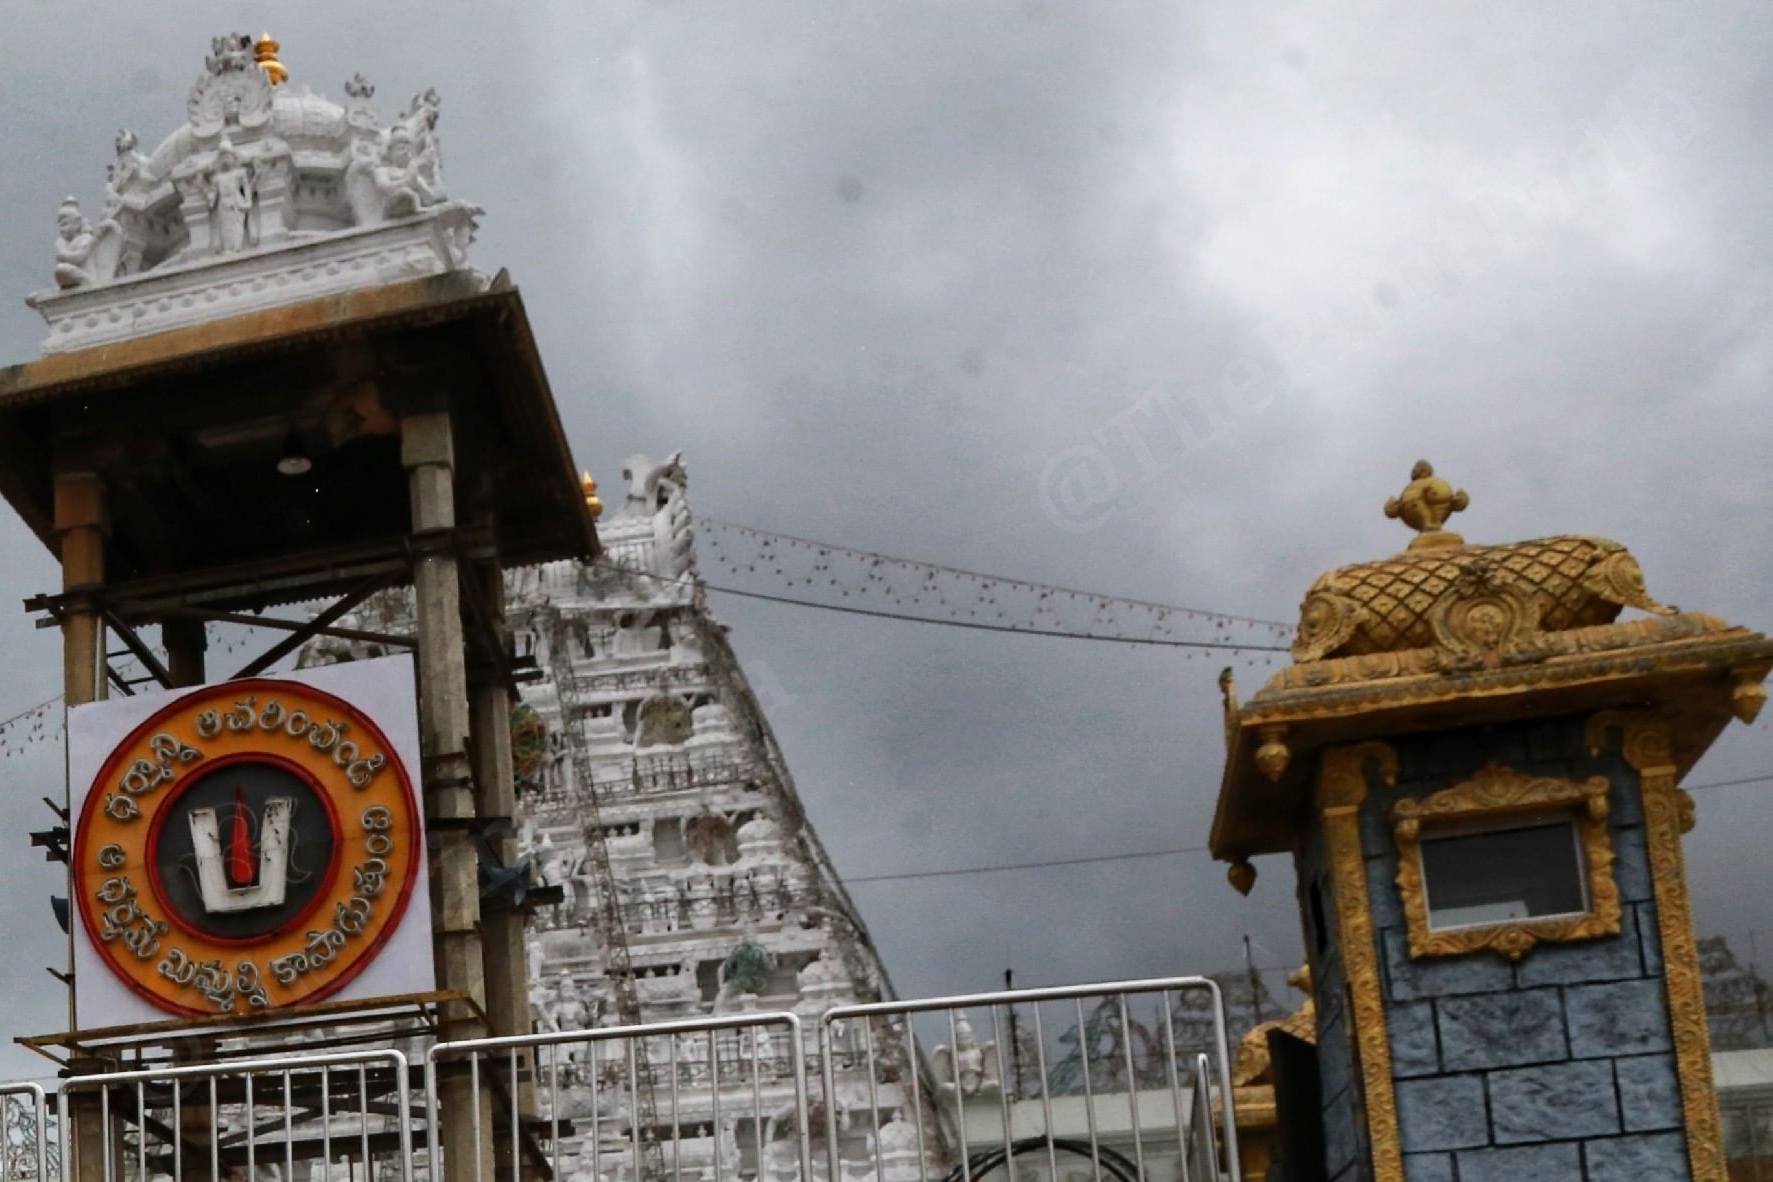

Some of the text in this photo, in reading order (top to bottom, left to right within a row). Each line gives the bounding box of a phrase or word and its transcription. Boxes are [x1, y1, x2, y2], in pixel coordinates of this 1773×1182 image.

[105, 696, 386, 821] ధర్మాన్ని ఆచరించండి
[95, 805, 392, 1012] ఆ ధర్మమే మిమ్మల్ని కాపాడుతుంది
